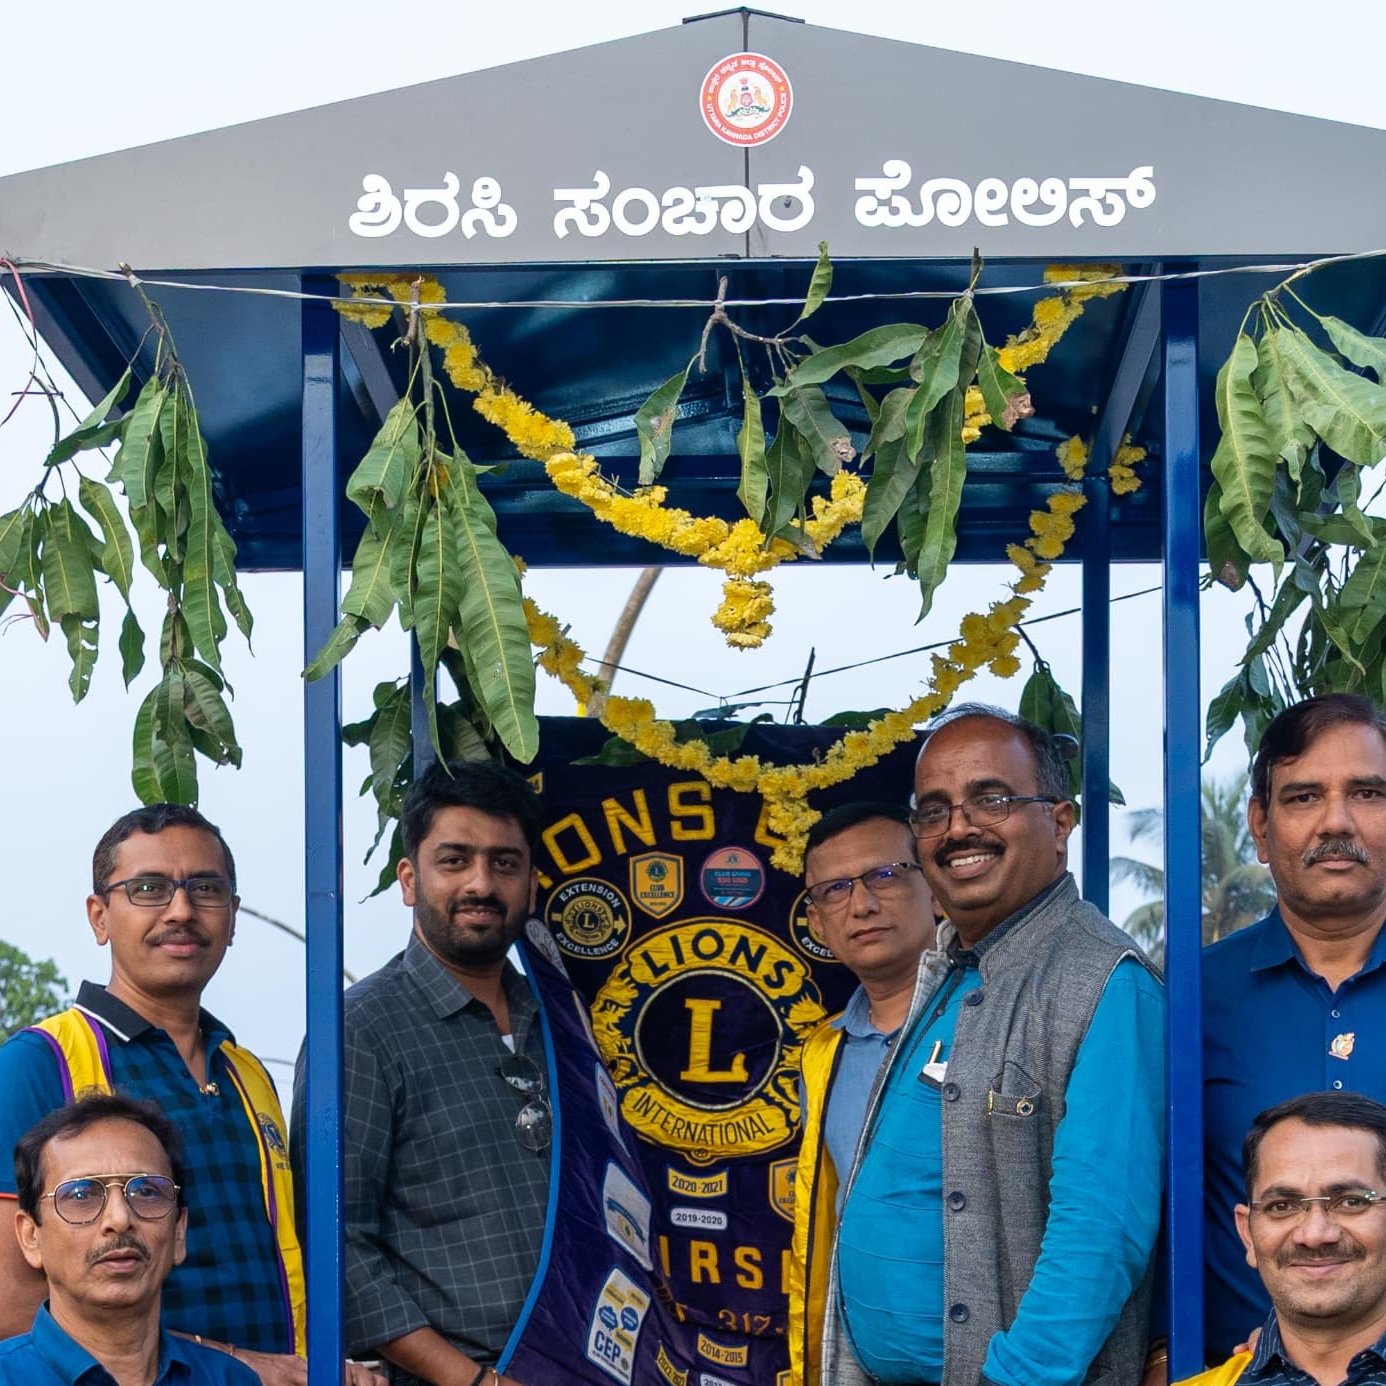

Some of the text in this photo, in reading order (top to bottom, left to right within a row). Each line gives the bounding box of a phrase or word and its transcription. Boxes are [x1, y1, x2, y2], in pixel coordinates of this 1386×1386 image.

[706, 93, 787, 140] UTTARA KANNADA DISTRICT POLICE
[348, 171, 517, 240] ಶಿರಸಿ
[553, 165, 815, 239] ಸಂಚಾರ
[537, 780, 715, 888] ONS
[559, 883, 621, 908] EXTENSION
[583, 912, 595, 928] L
[556, 932, 619, 955] EXCELLENCE
[640, 928, 795, 989] LIONS
[680, 998, 749, 1082] L
[632, 1092, 775, 1146] INTERNATIONAL
[672, 1175, 723, 1193] 2020-2021
[676, 1213, 723, 1225] 2019-2020
[659, 1236, 791, 1294] IRSI
[594, 1330, 621, 1362] CEP
[701, 1339, 743, 1363] 2014-2015
